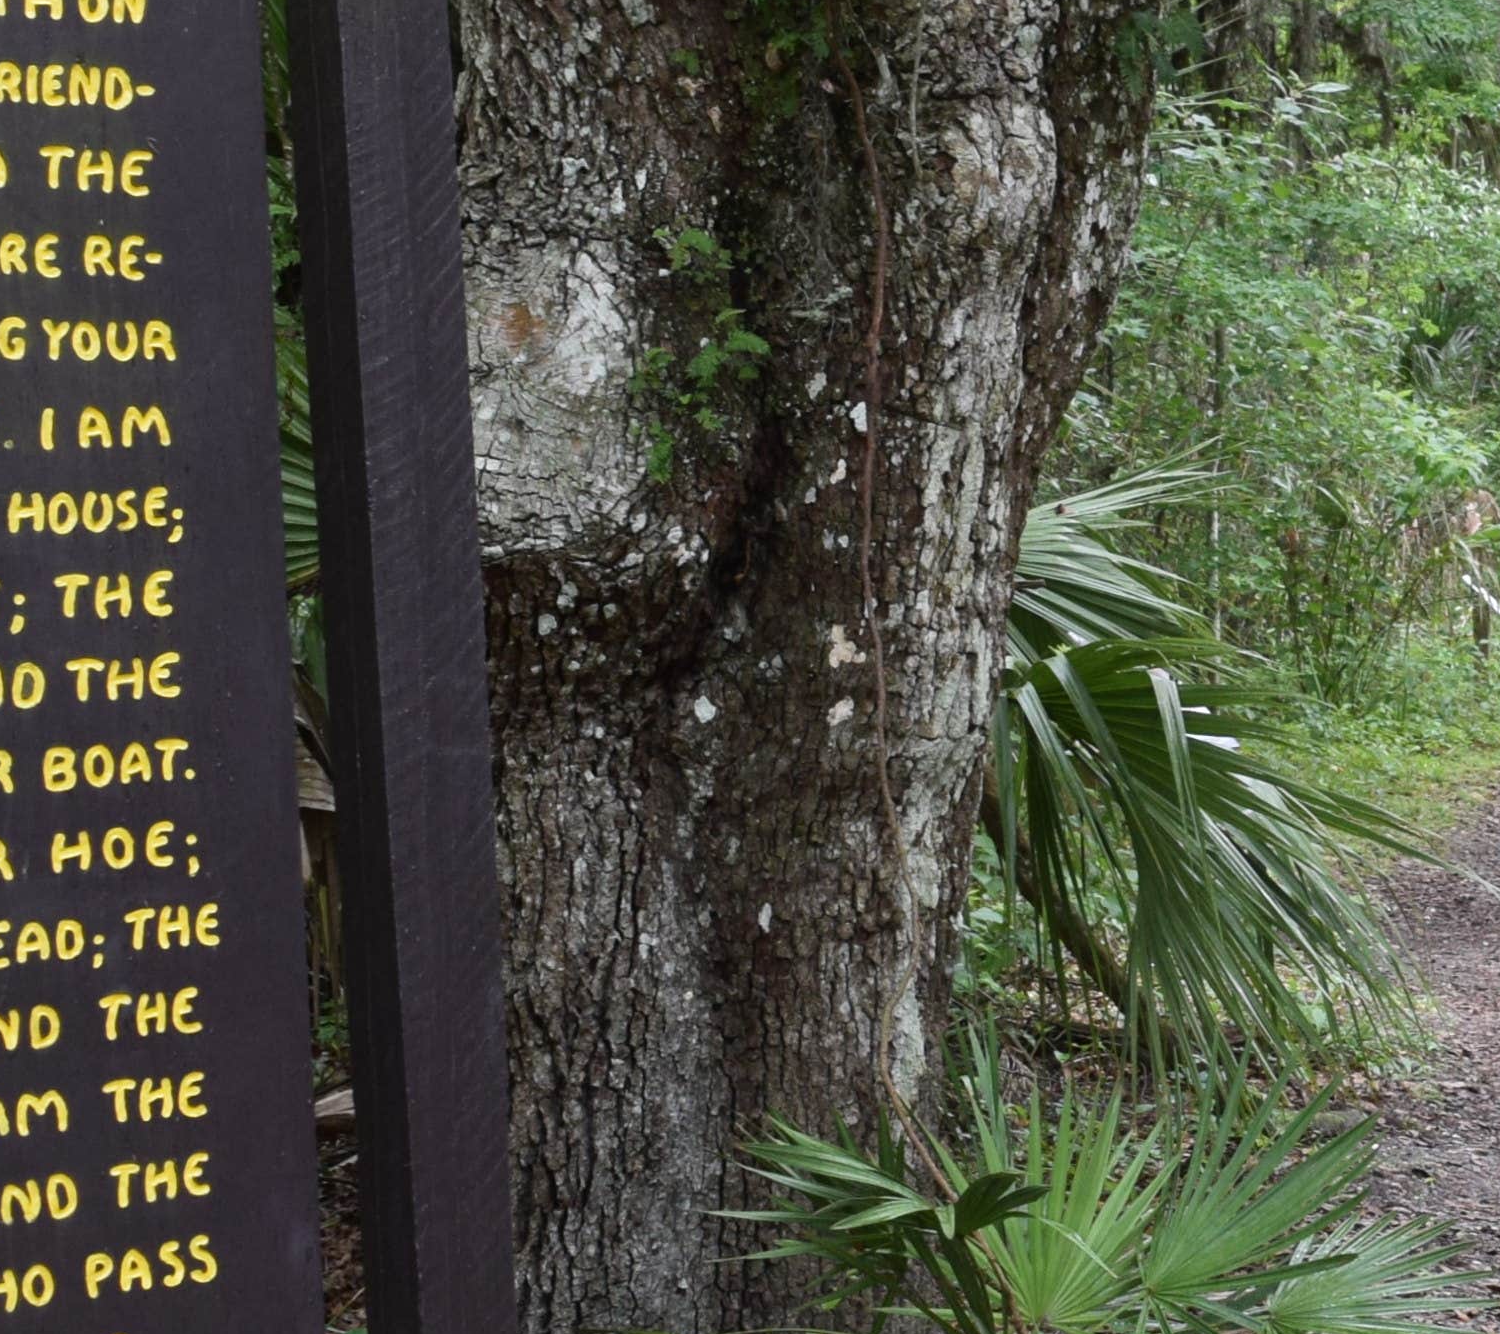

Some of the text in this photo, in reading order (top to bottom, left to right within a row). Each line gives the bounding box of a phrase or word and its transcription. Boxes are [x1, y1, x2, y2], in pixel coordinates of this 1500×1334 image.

[38, 145, 153, 195] THE
[82, 235, 163, 280] RE-
[41, 319, 177, 362] YOUR
[39, 407, 55, 451] I
[77, 405, 171, 448] AM
[7, 486, 183, 541] HOUSE;
[53, 569, 173, 619] THE
[65, 651, 181, 700] THE
[42, 738, 196, 793] BOAT.
[50, 821, 200, 874] HOE;
[124, 903, 220, 950] THE
[99, 987, 203, 1040] THE
[102, 1071, 207, 1123] THE
[109, 1152, 211, 1208] THE
[84, 1234, 217, 1299] PASS
